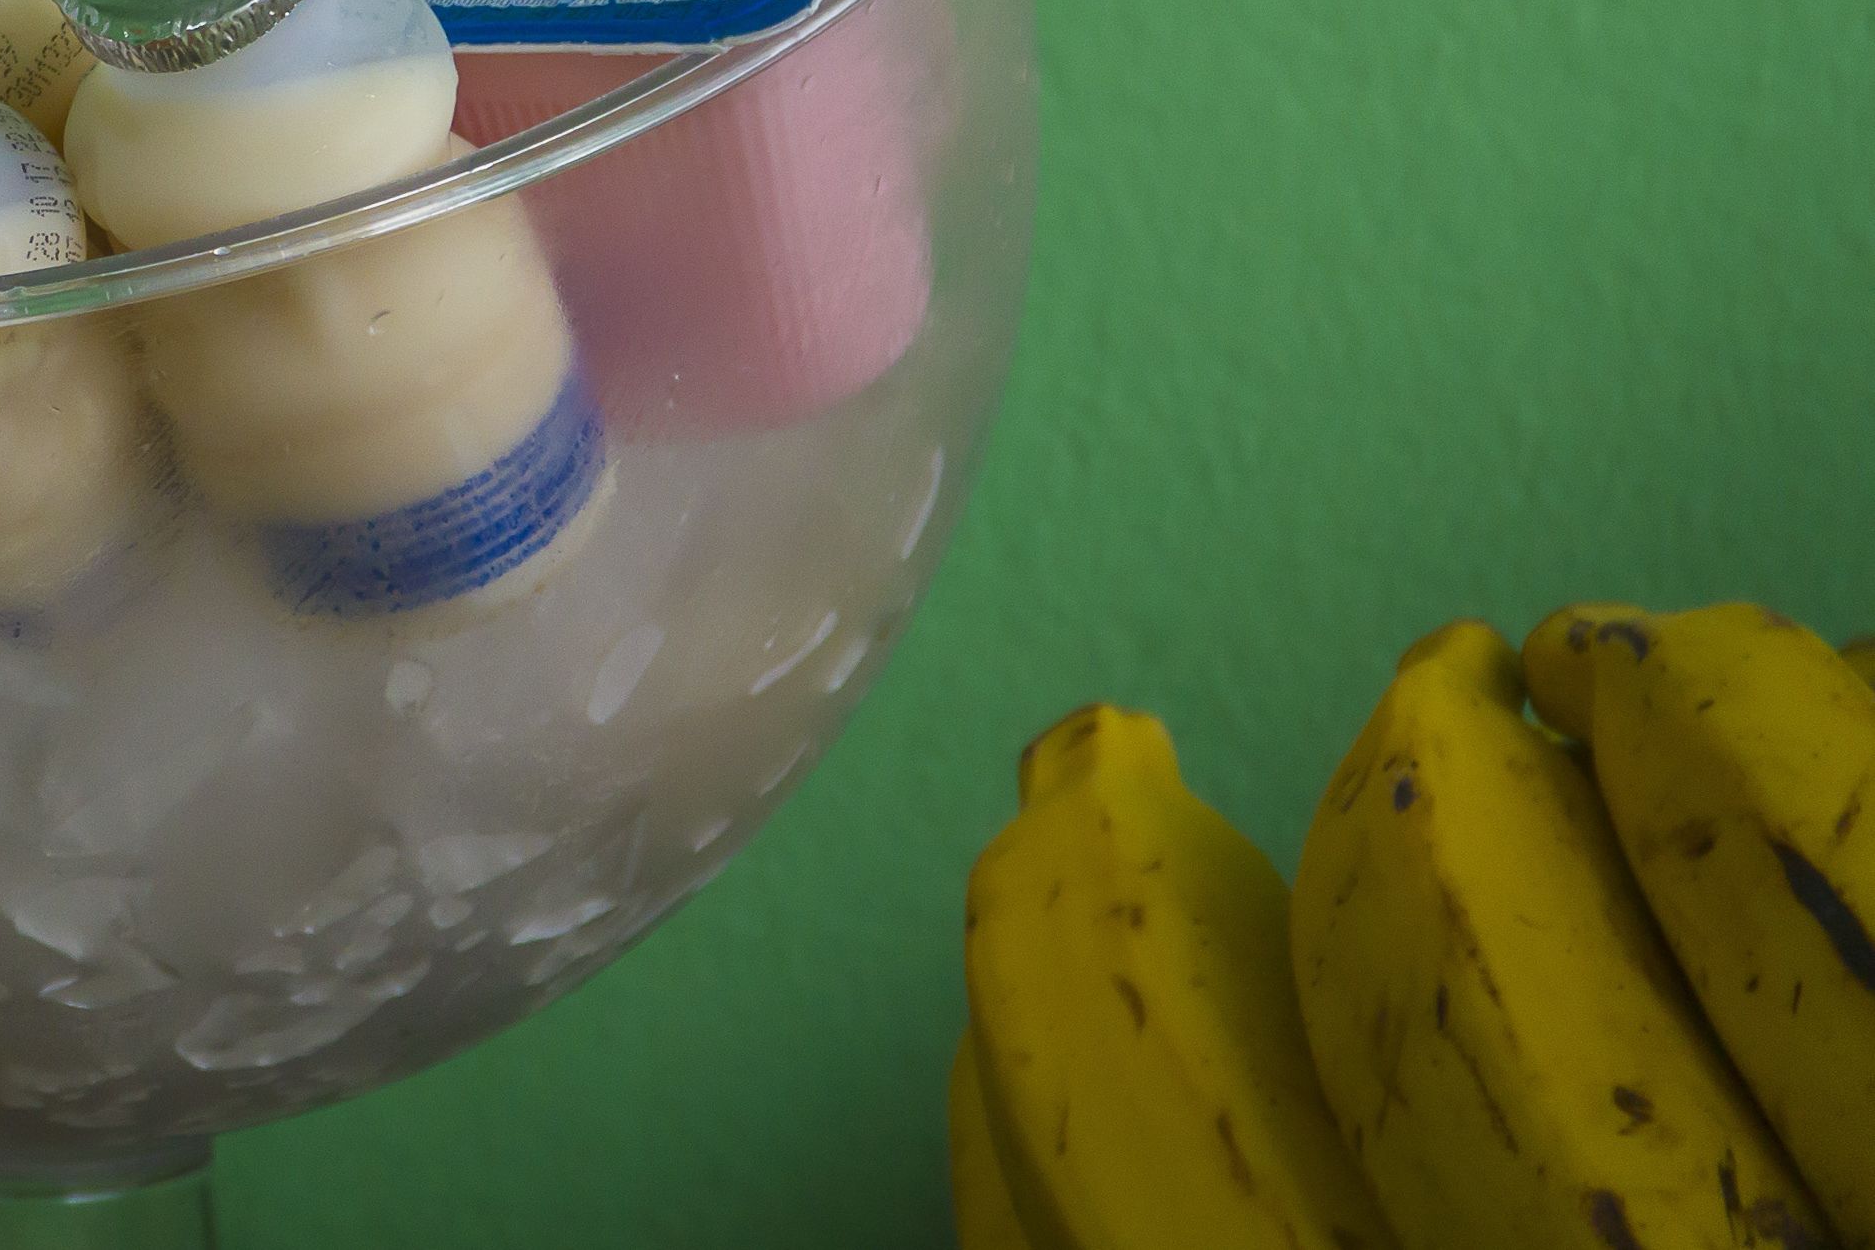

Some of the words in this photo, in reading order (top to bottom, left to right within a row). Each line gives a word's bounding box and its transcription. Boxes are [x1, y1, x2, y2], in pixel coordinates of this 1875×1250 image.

[21, 162, 54, 184] 17
[29, 195, 61, 218] 10
[26, 231, 61, 263] 28
